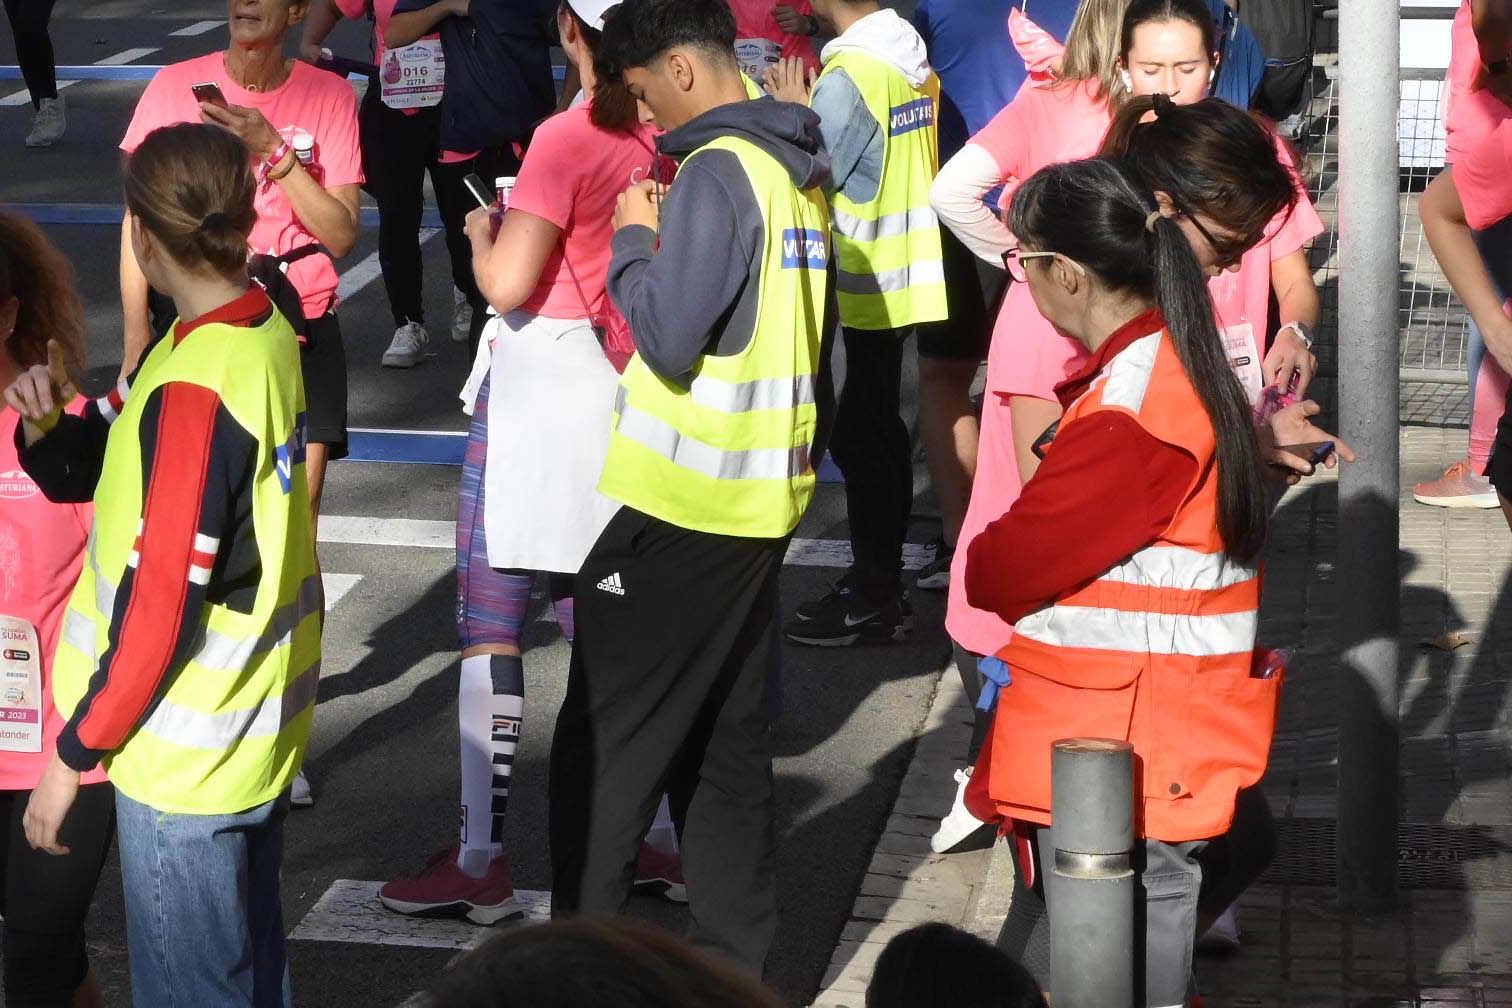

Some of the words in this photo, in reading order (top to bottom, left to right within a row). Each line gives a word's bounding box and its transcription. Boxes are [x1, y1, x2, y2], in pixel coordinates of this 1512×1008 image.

[404, 67, 428, 77] 016
[596, 582, 626, 596] adidas
[1, 632, 28, 641] SUMA
[7, 711, 27, 720] 2023
